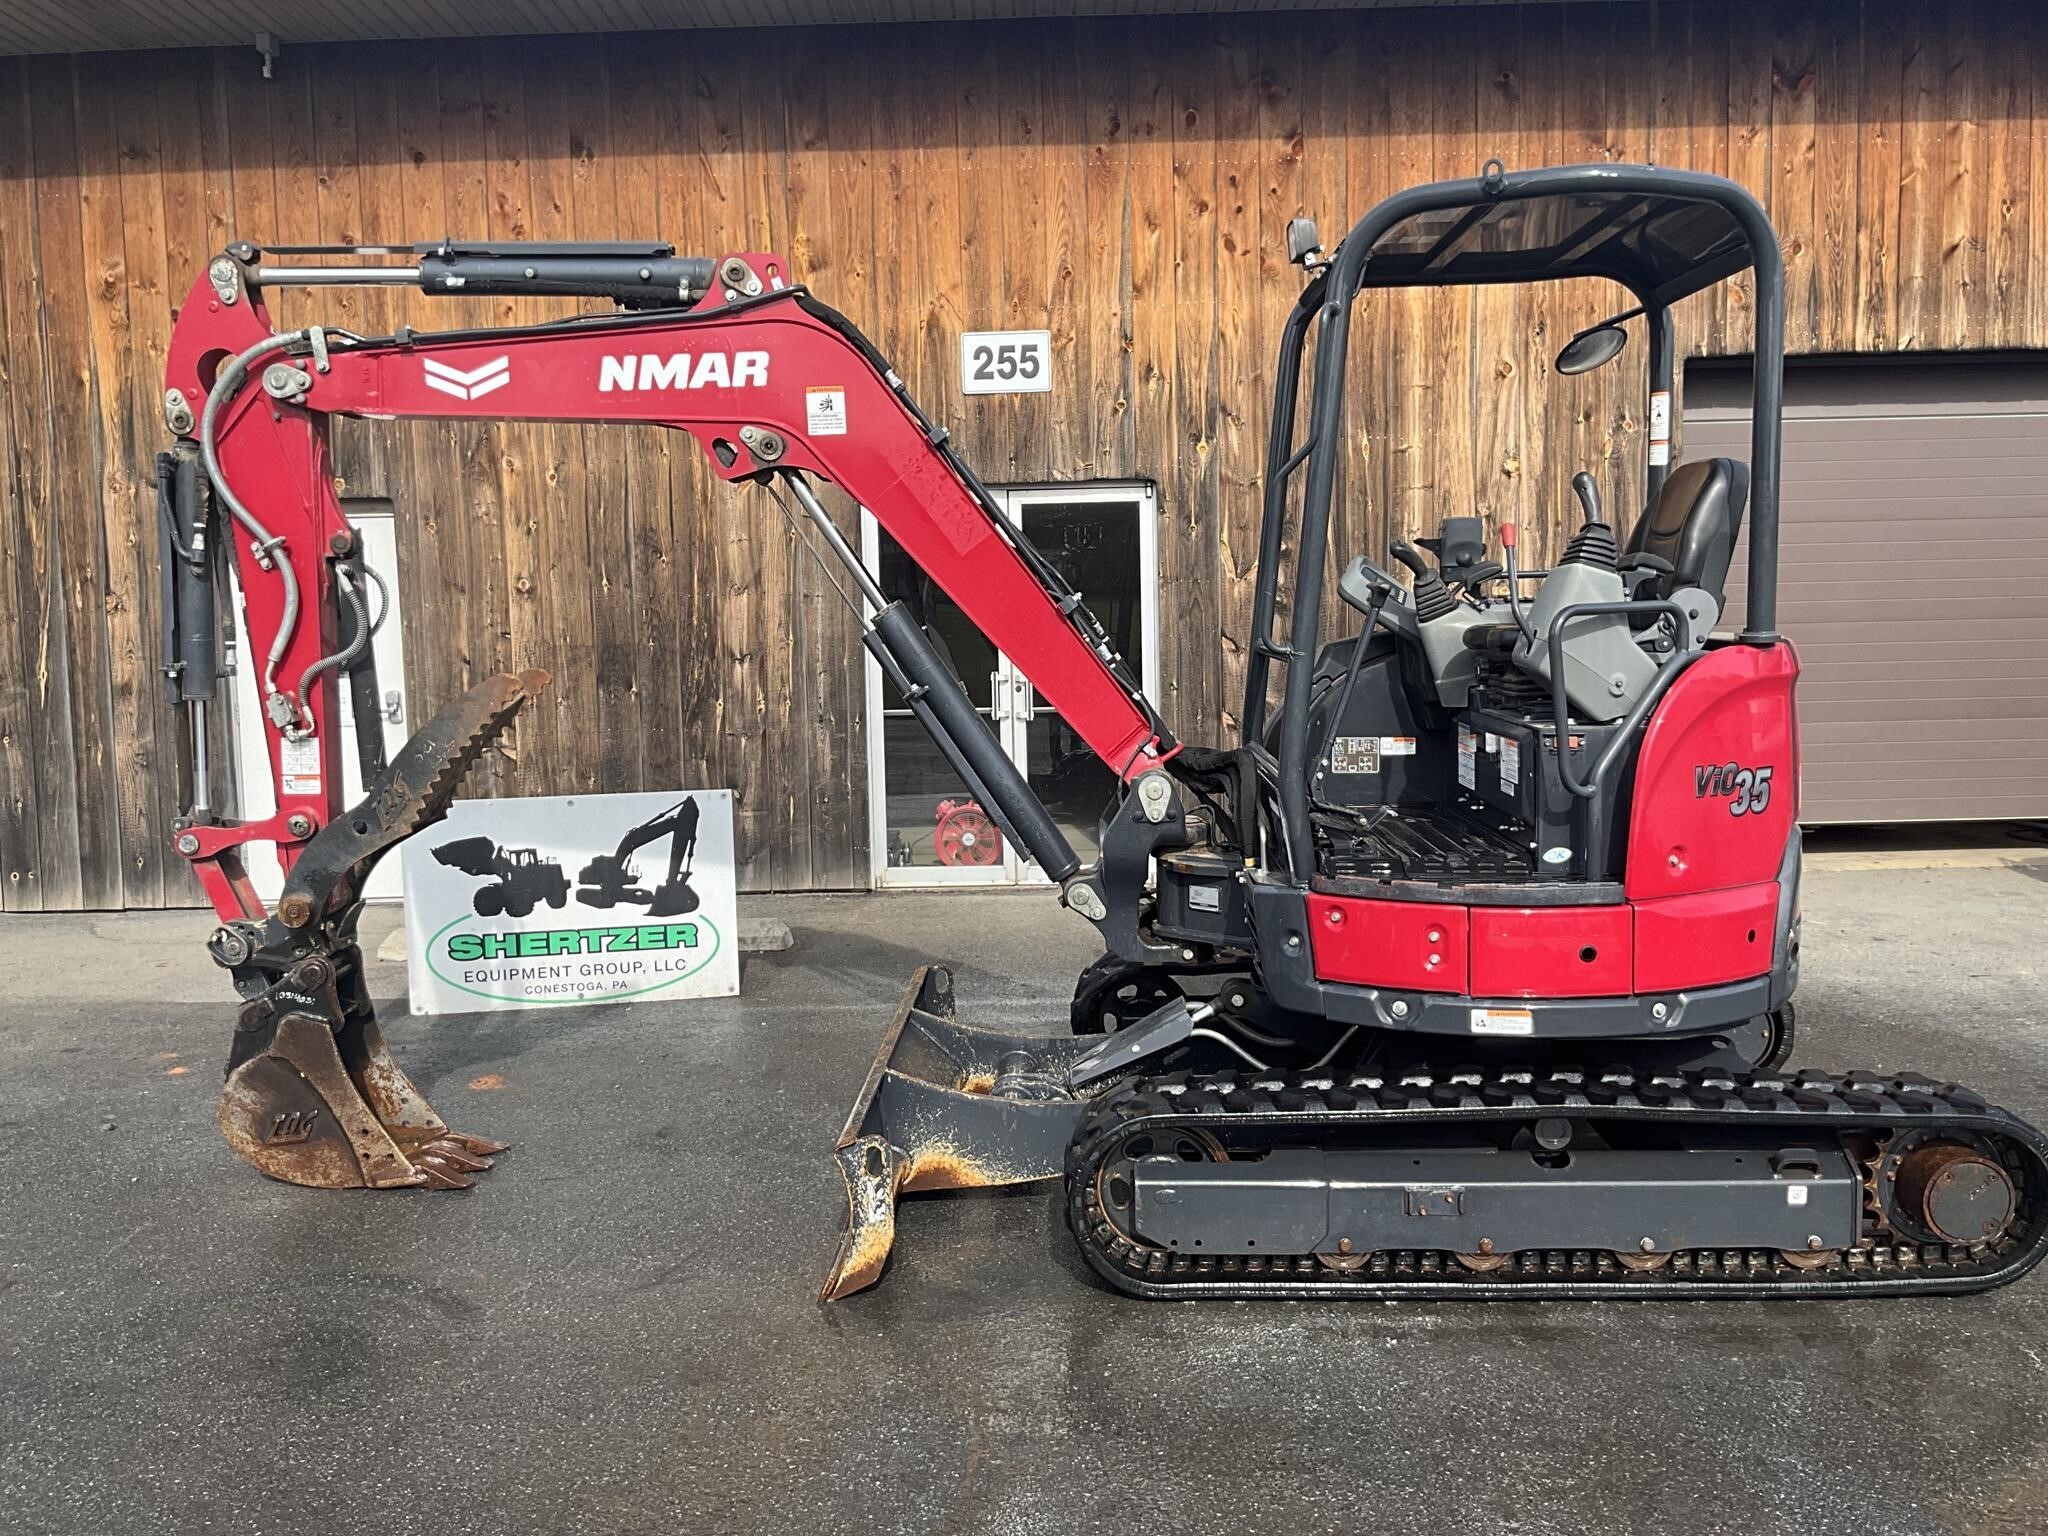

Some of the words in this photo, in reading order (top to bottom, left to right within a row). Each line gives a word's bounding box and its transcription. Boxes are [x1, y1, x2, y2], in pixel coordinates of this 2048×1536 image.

[599, 351, 769, 392] NMAR
[973, 344, 1040, 380] 255
[448, 923, 698, 961] SHERTZER
[464, 965, 572, 983] EQUIPMENT
[579, 961, 646, 977] GROUP,
[654, 958, 687, 972] LLC
[612, 980, 628, 989] PA
